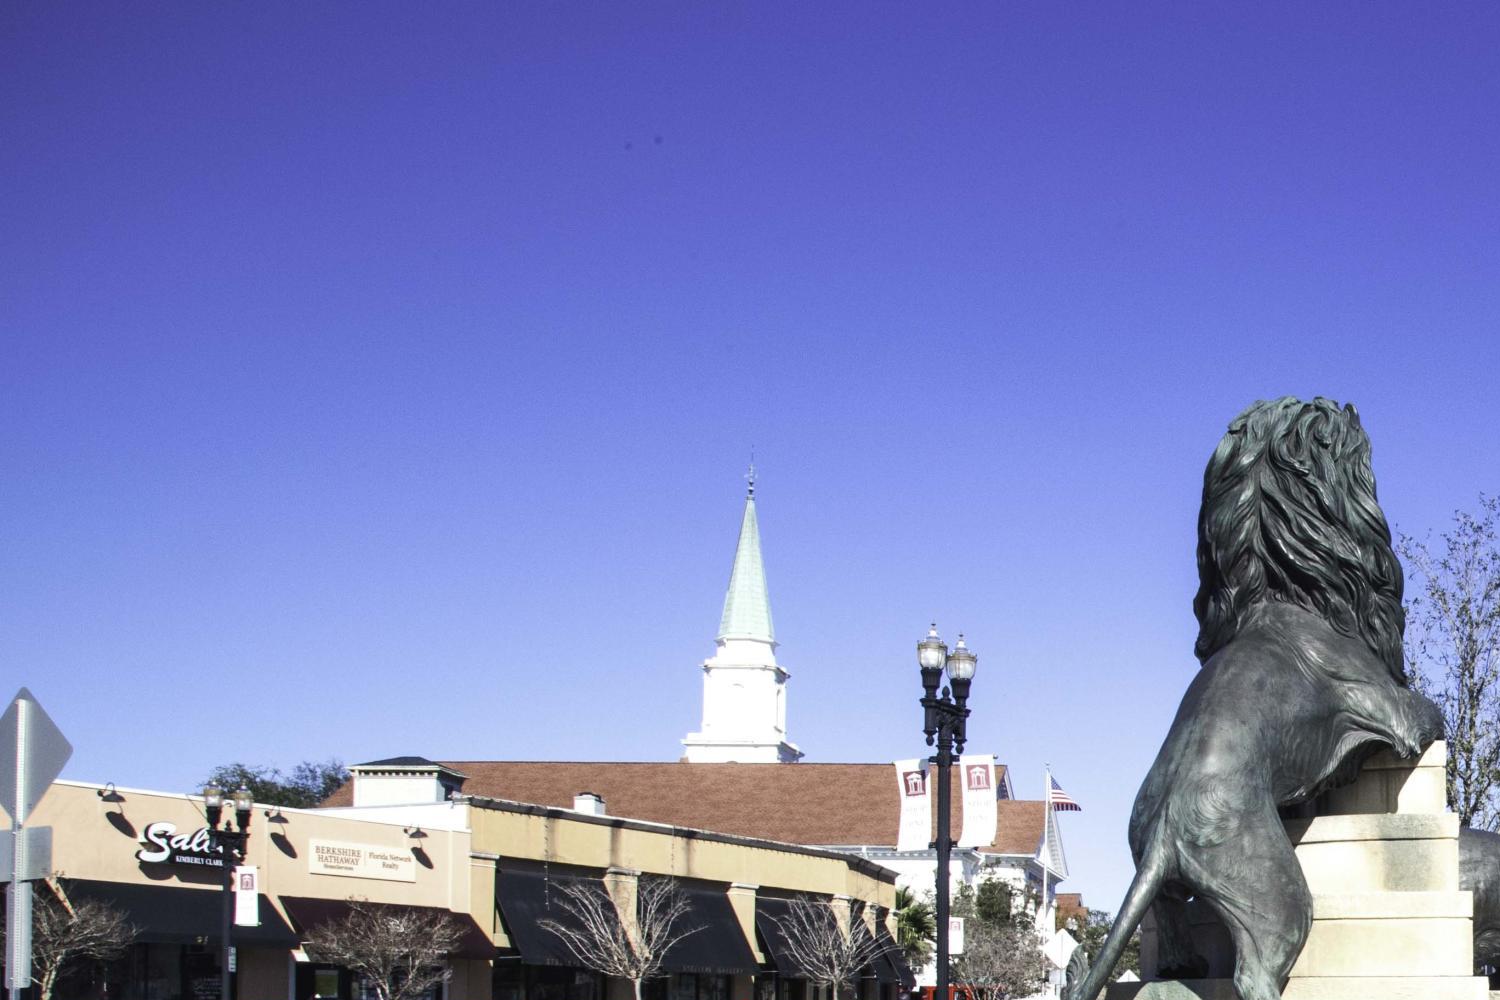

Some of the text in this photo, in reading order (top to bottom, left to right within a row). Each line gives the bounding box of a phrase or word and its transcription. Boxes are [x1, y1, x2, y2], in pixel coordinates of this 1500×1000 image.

[315, 845, 361, 858] BERKSHIRE
[175, 855, 205, 865] KIMBERLY
[318, 854, 360, 866] HATHAWAY
[368, 852, 412, 863] Florida Network
[382, 861, 399, 871] Realty
